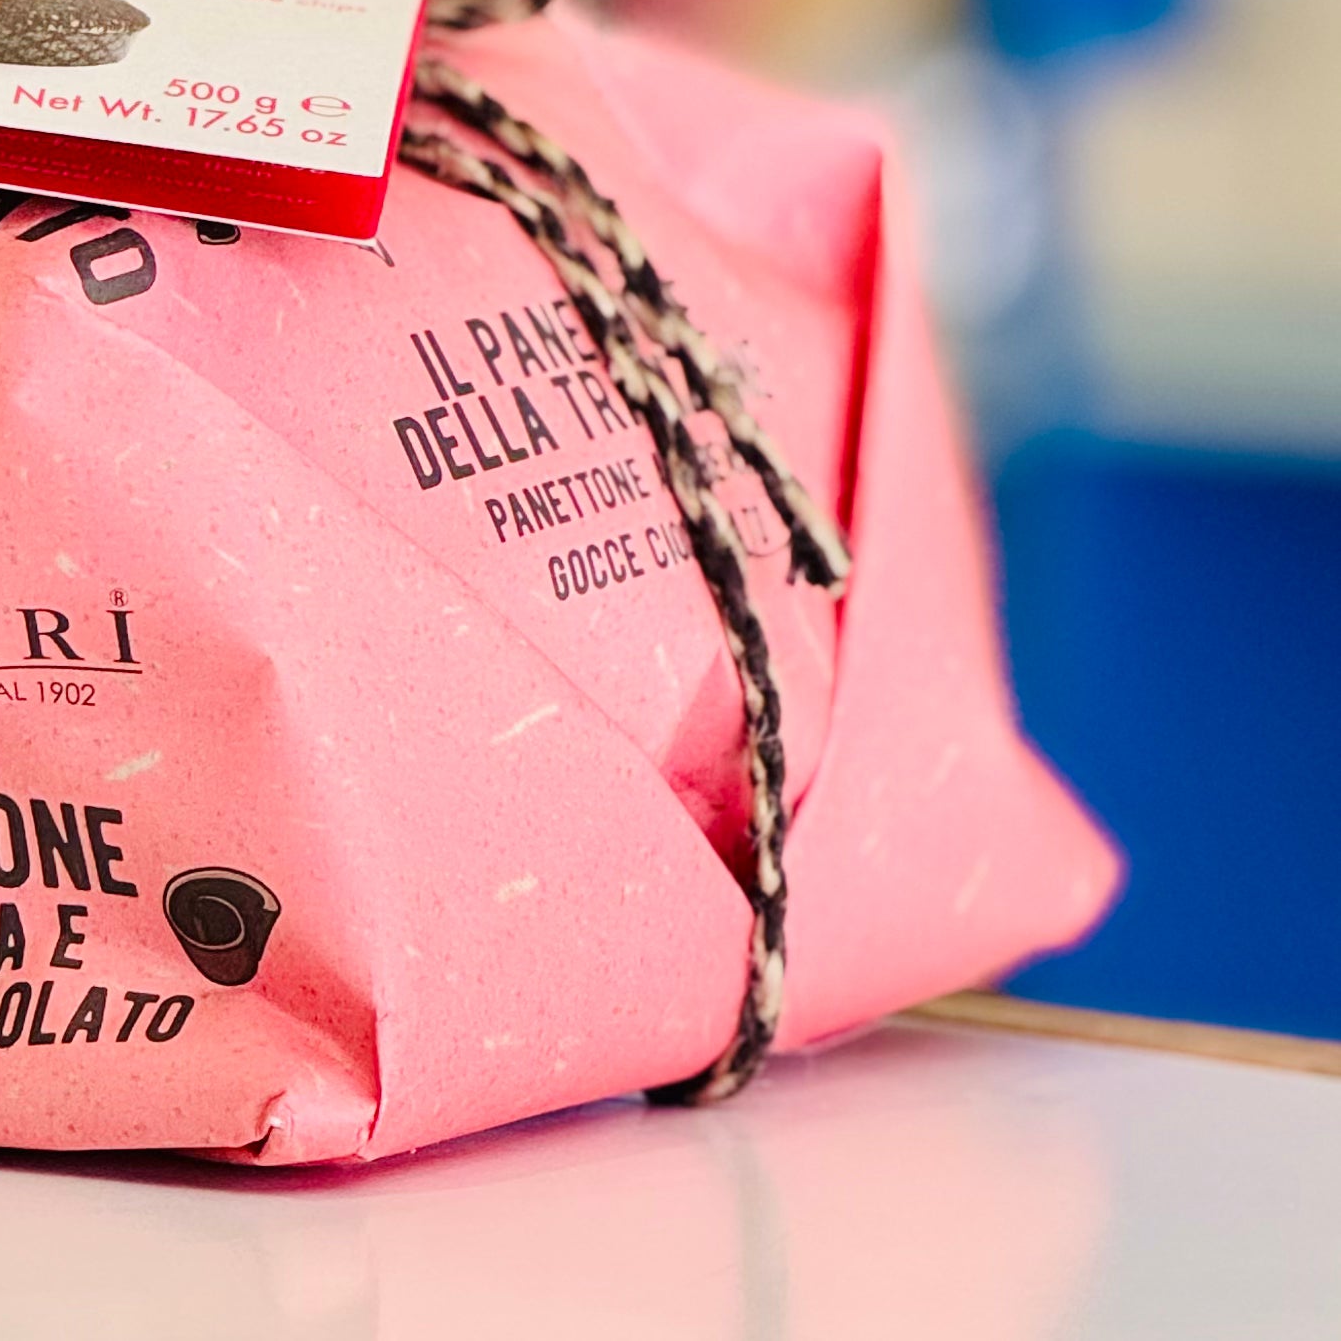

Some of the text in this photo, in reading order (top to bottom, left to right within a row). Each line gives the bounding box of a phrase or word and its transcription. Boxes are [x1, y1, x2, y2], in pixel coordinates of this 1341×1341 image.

[13, 85, 348, 146] Net Wt. 17.65 oz
[164, 78, 241, 104] 500
[255, 96, 277, 114] g
[410, 329, 475, 401] IL
[393, 386, 559, 491] DELLA
[484, 457, 651, 543] PANETTONE
[548, 534, 645, 601] GOCCE
[37, 680, 97, 707] 1902
[49, 903, 89, 970] E
